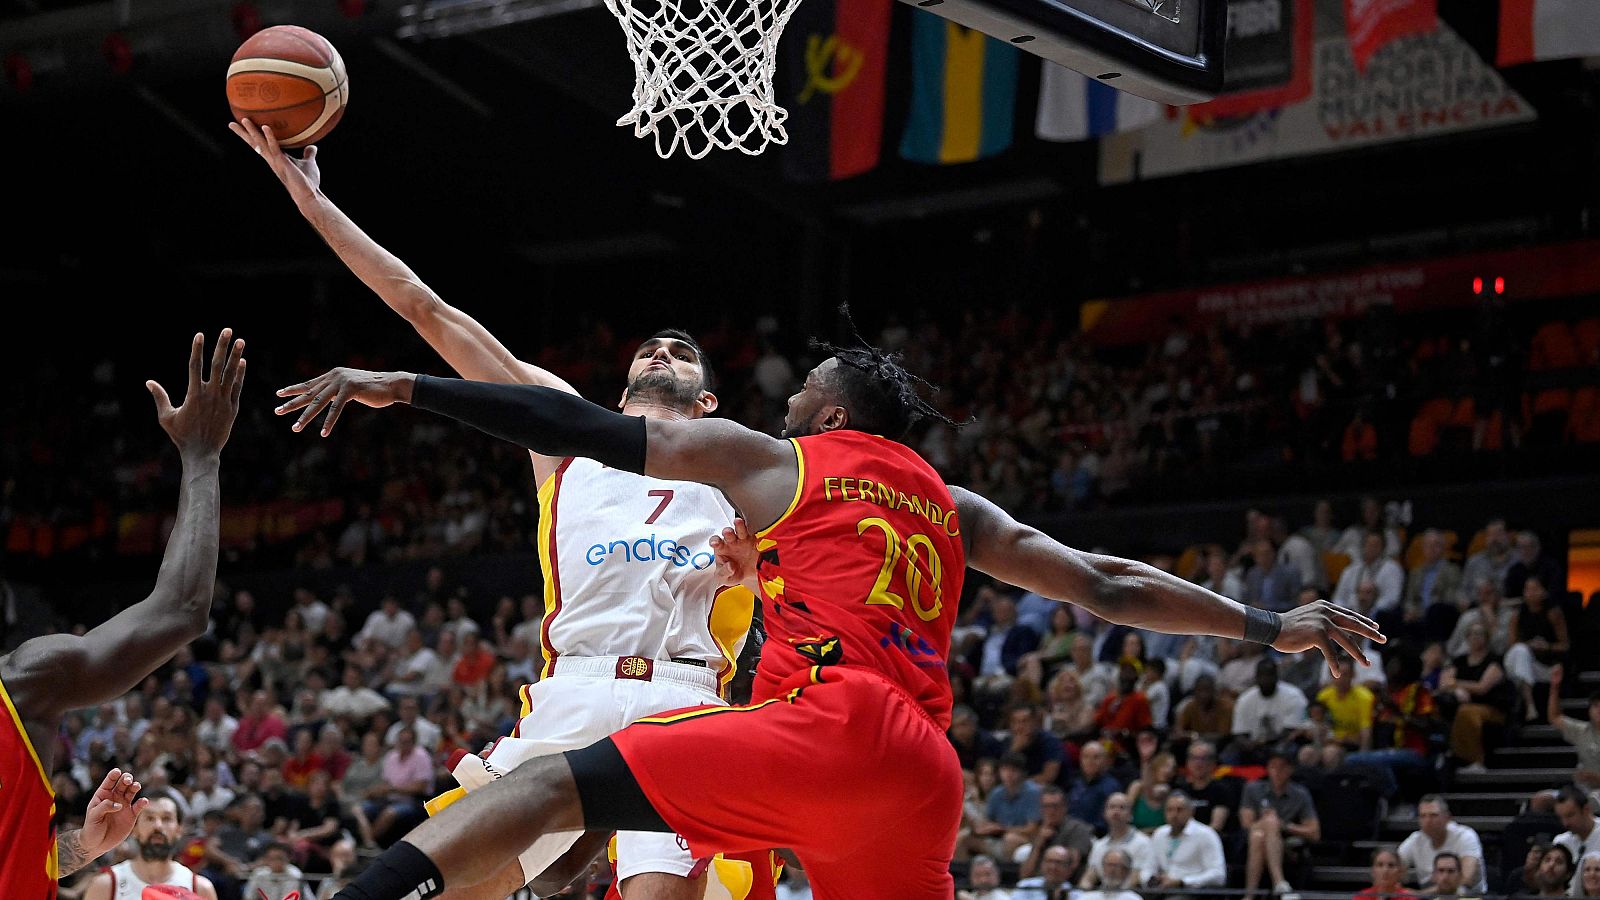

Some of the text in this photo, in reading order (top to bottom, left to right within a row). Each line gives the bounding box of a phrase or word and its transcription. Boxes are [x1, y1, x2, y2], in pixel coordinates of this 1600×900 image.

[1318, 75, 1504, 120] MUNICIPA
[1324, 96, 1521, 140] VALENCIA
[645, 489, 675, 525] 7
[823, 477, 960, 537] FERNANDO
[857, 517, 943, 622] 20
